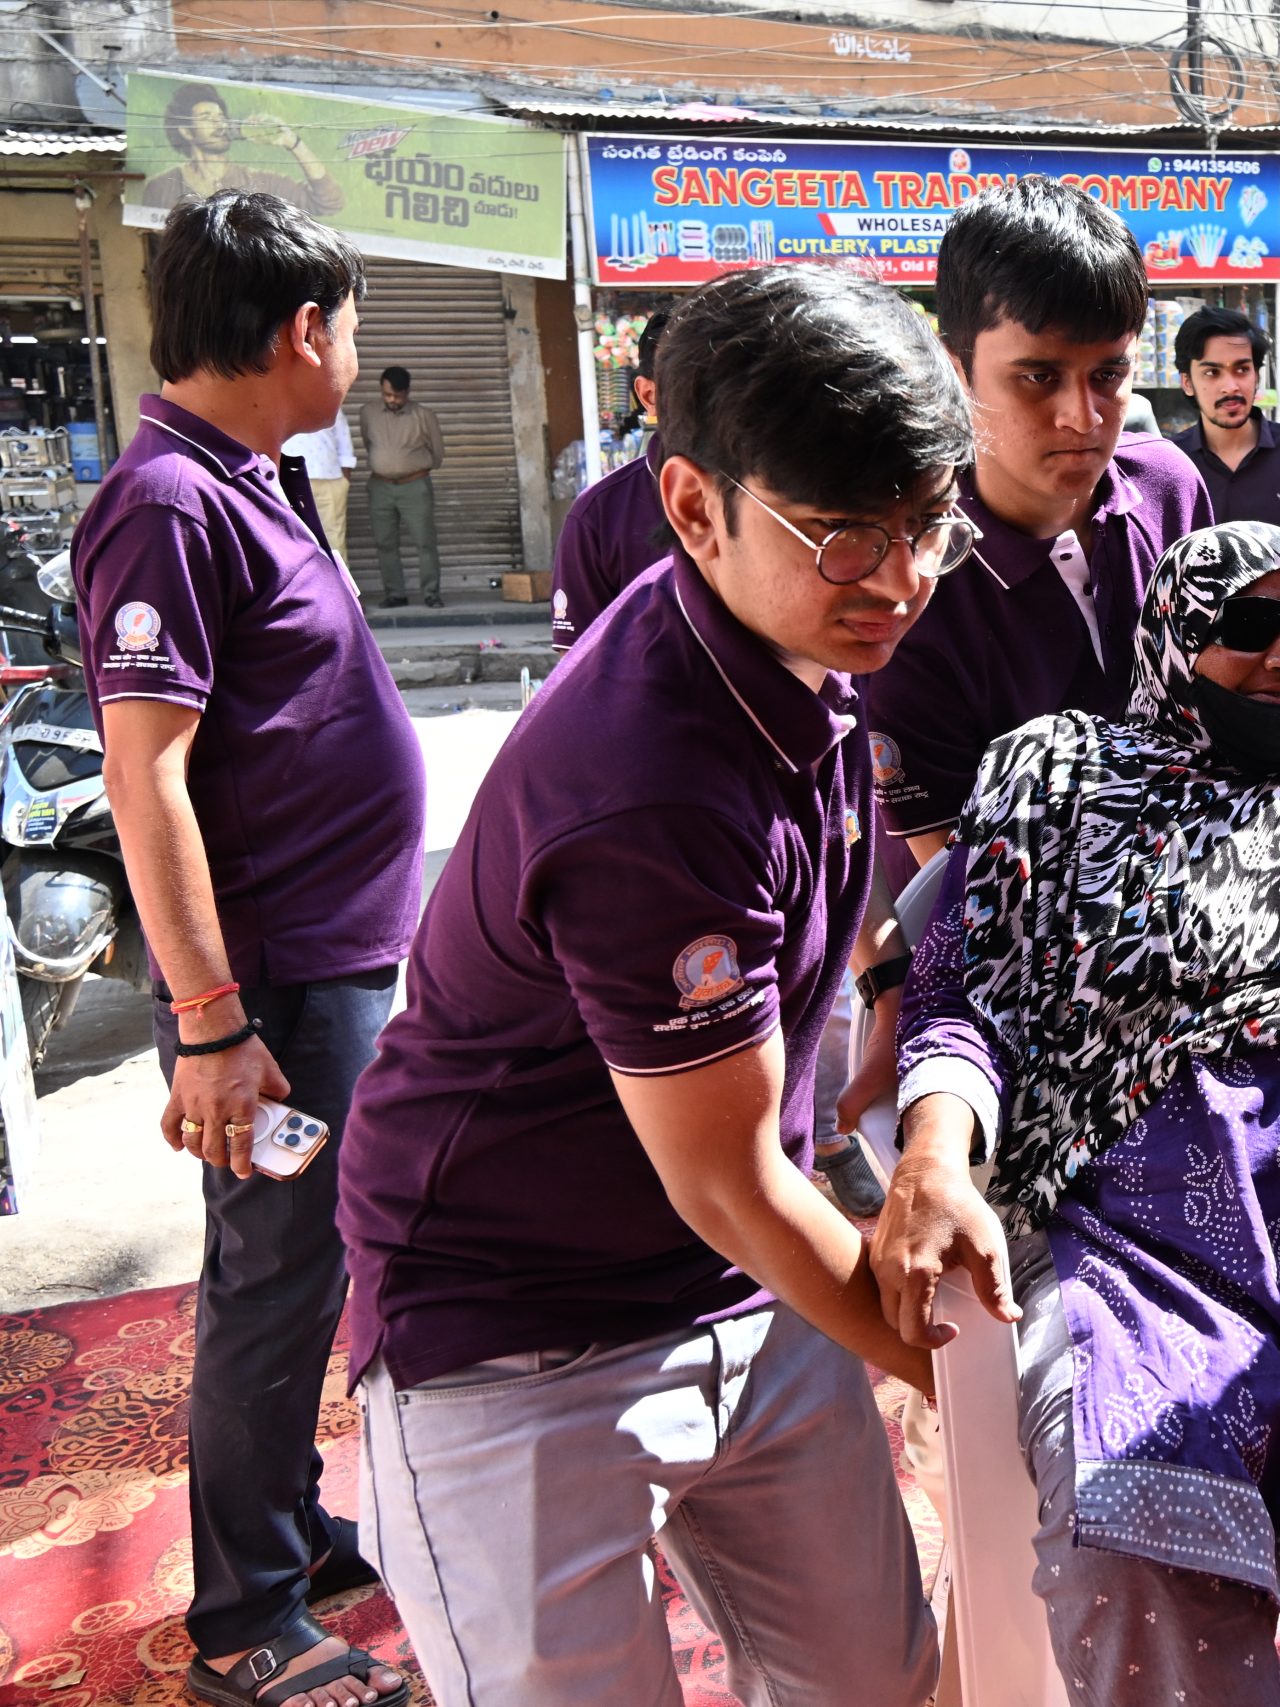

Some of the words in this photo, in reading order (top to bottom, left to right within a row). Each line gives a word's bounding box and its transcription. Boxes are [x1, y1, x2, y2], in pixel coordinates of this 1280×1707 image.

[602, 144, 661, 160] సంగీత
[652, 165, 868, 209] SANGEETA
[873, 172, 1044, 208] TRADI
[880, 238, 942, 254] PLAST
[901, 260, 924, 272] Old
